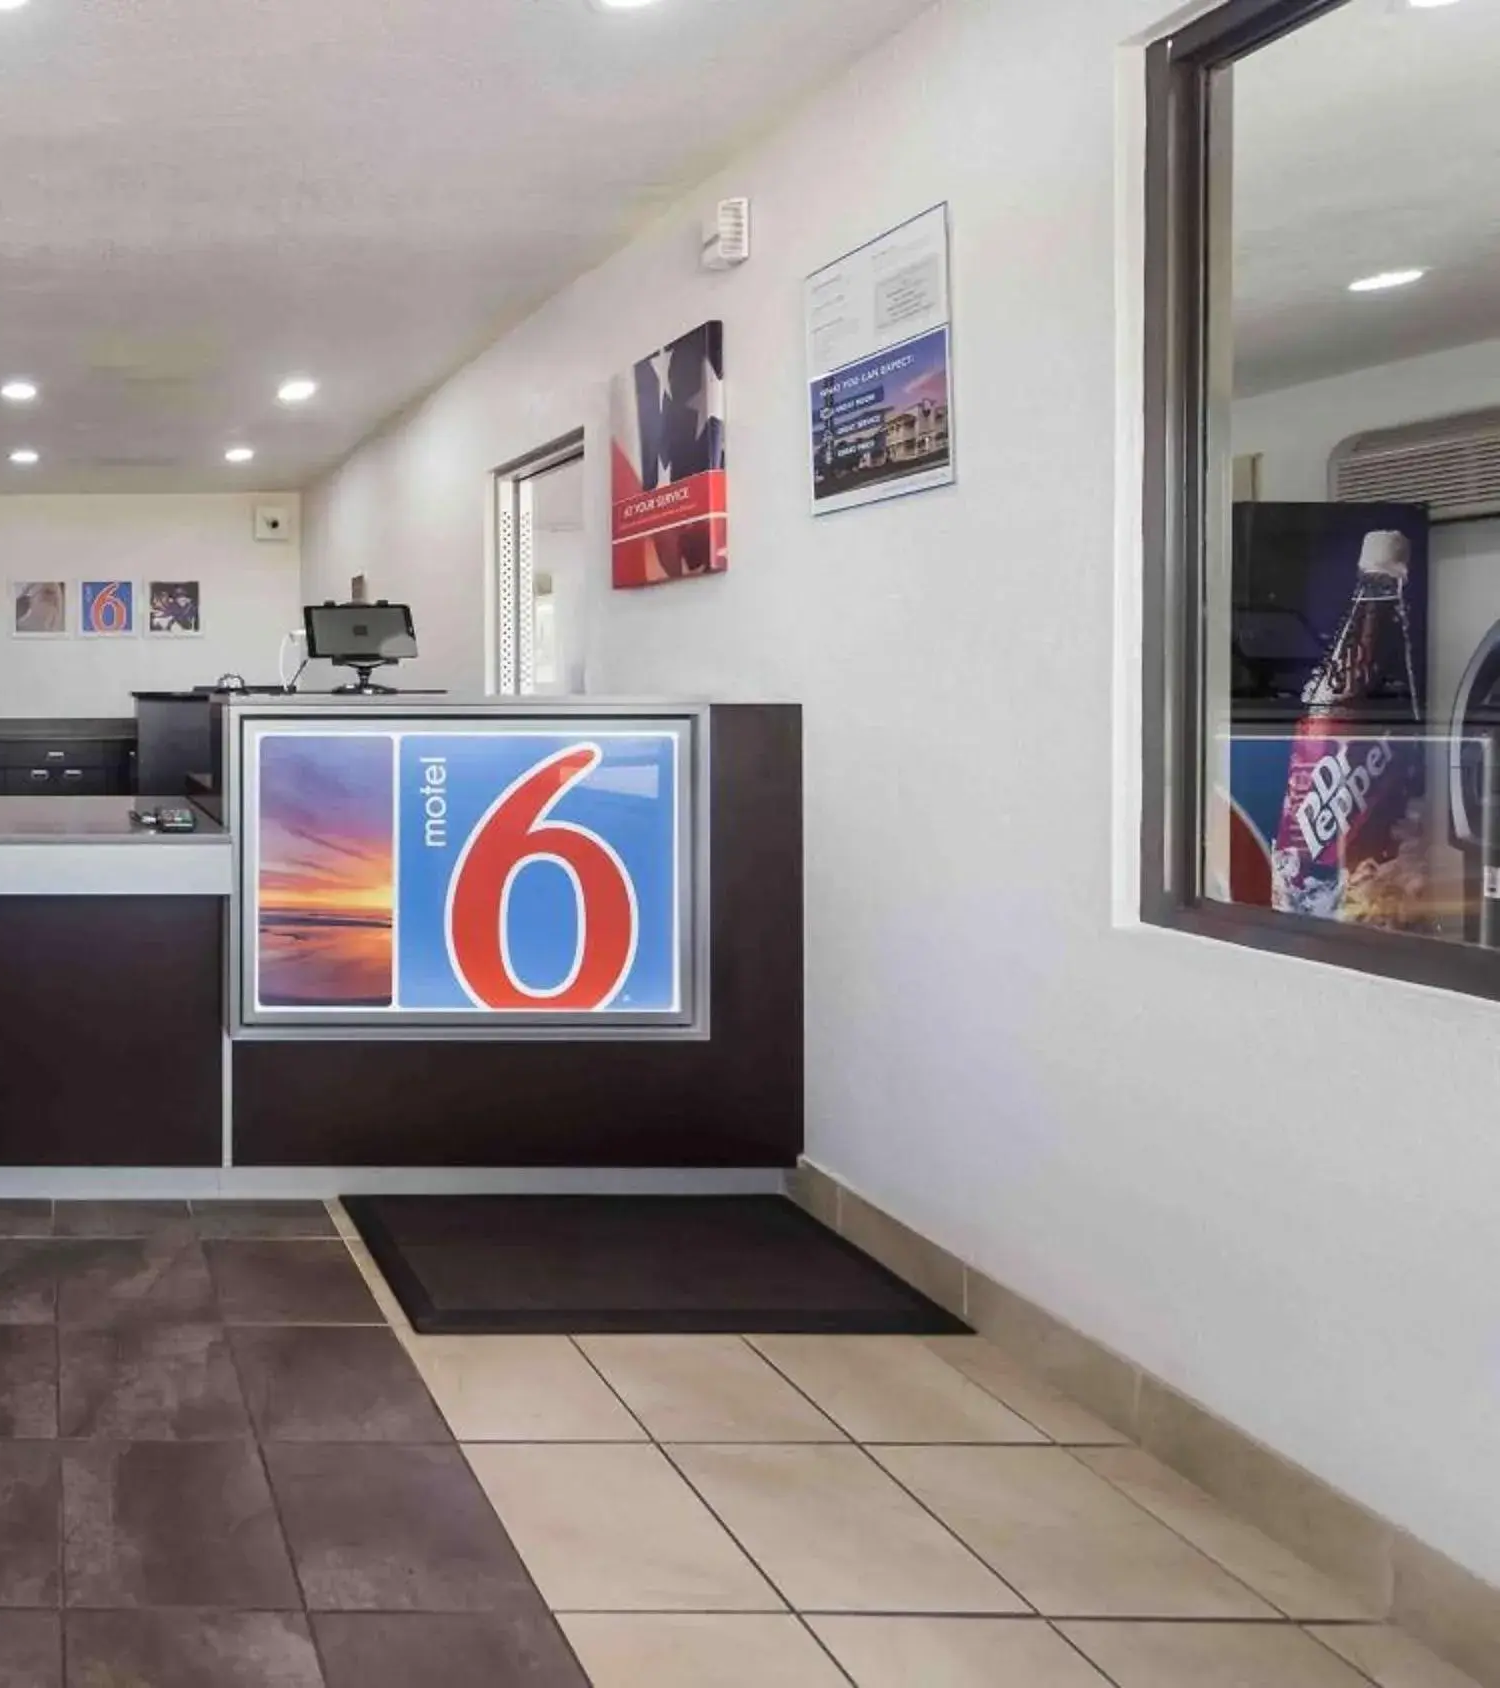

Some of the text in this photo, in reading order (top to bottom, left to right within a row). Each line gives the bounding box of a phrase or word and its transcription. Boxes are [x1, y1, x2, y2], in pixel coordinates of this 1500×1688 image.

[634, 500, 655, 514] YOUR
[656, 486, 690, 508] SERVICE
[90, 582, 127, 635] 6
[420, 757, 446, 847] motel
[1297, 731, 1393, 860] Pepper
[1311, 740, 1351, 800] Dr
[444, 742, 639, 1012] 6
